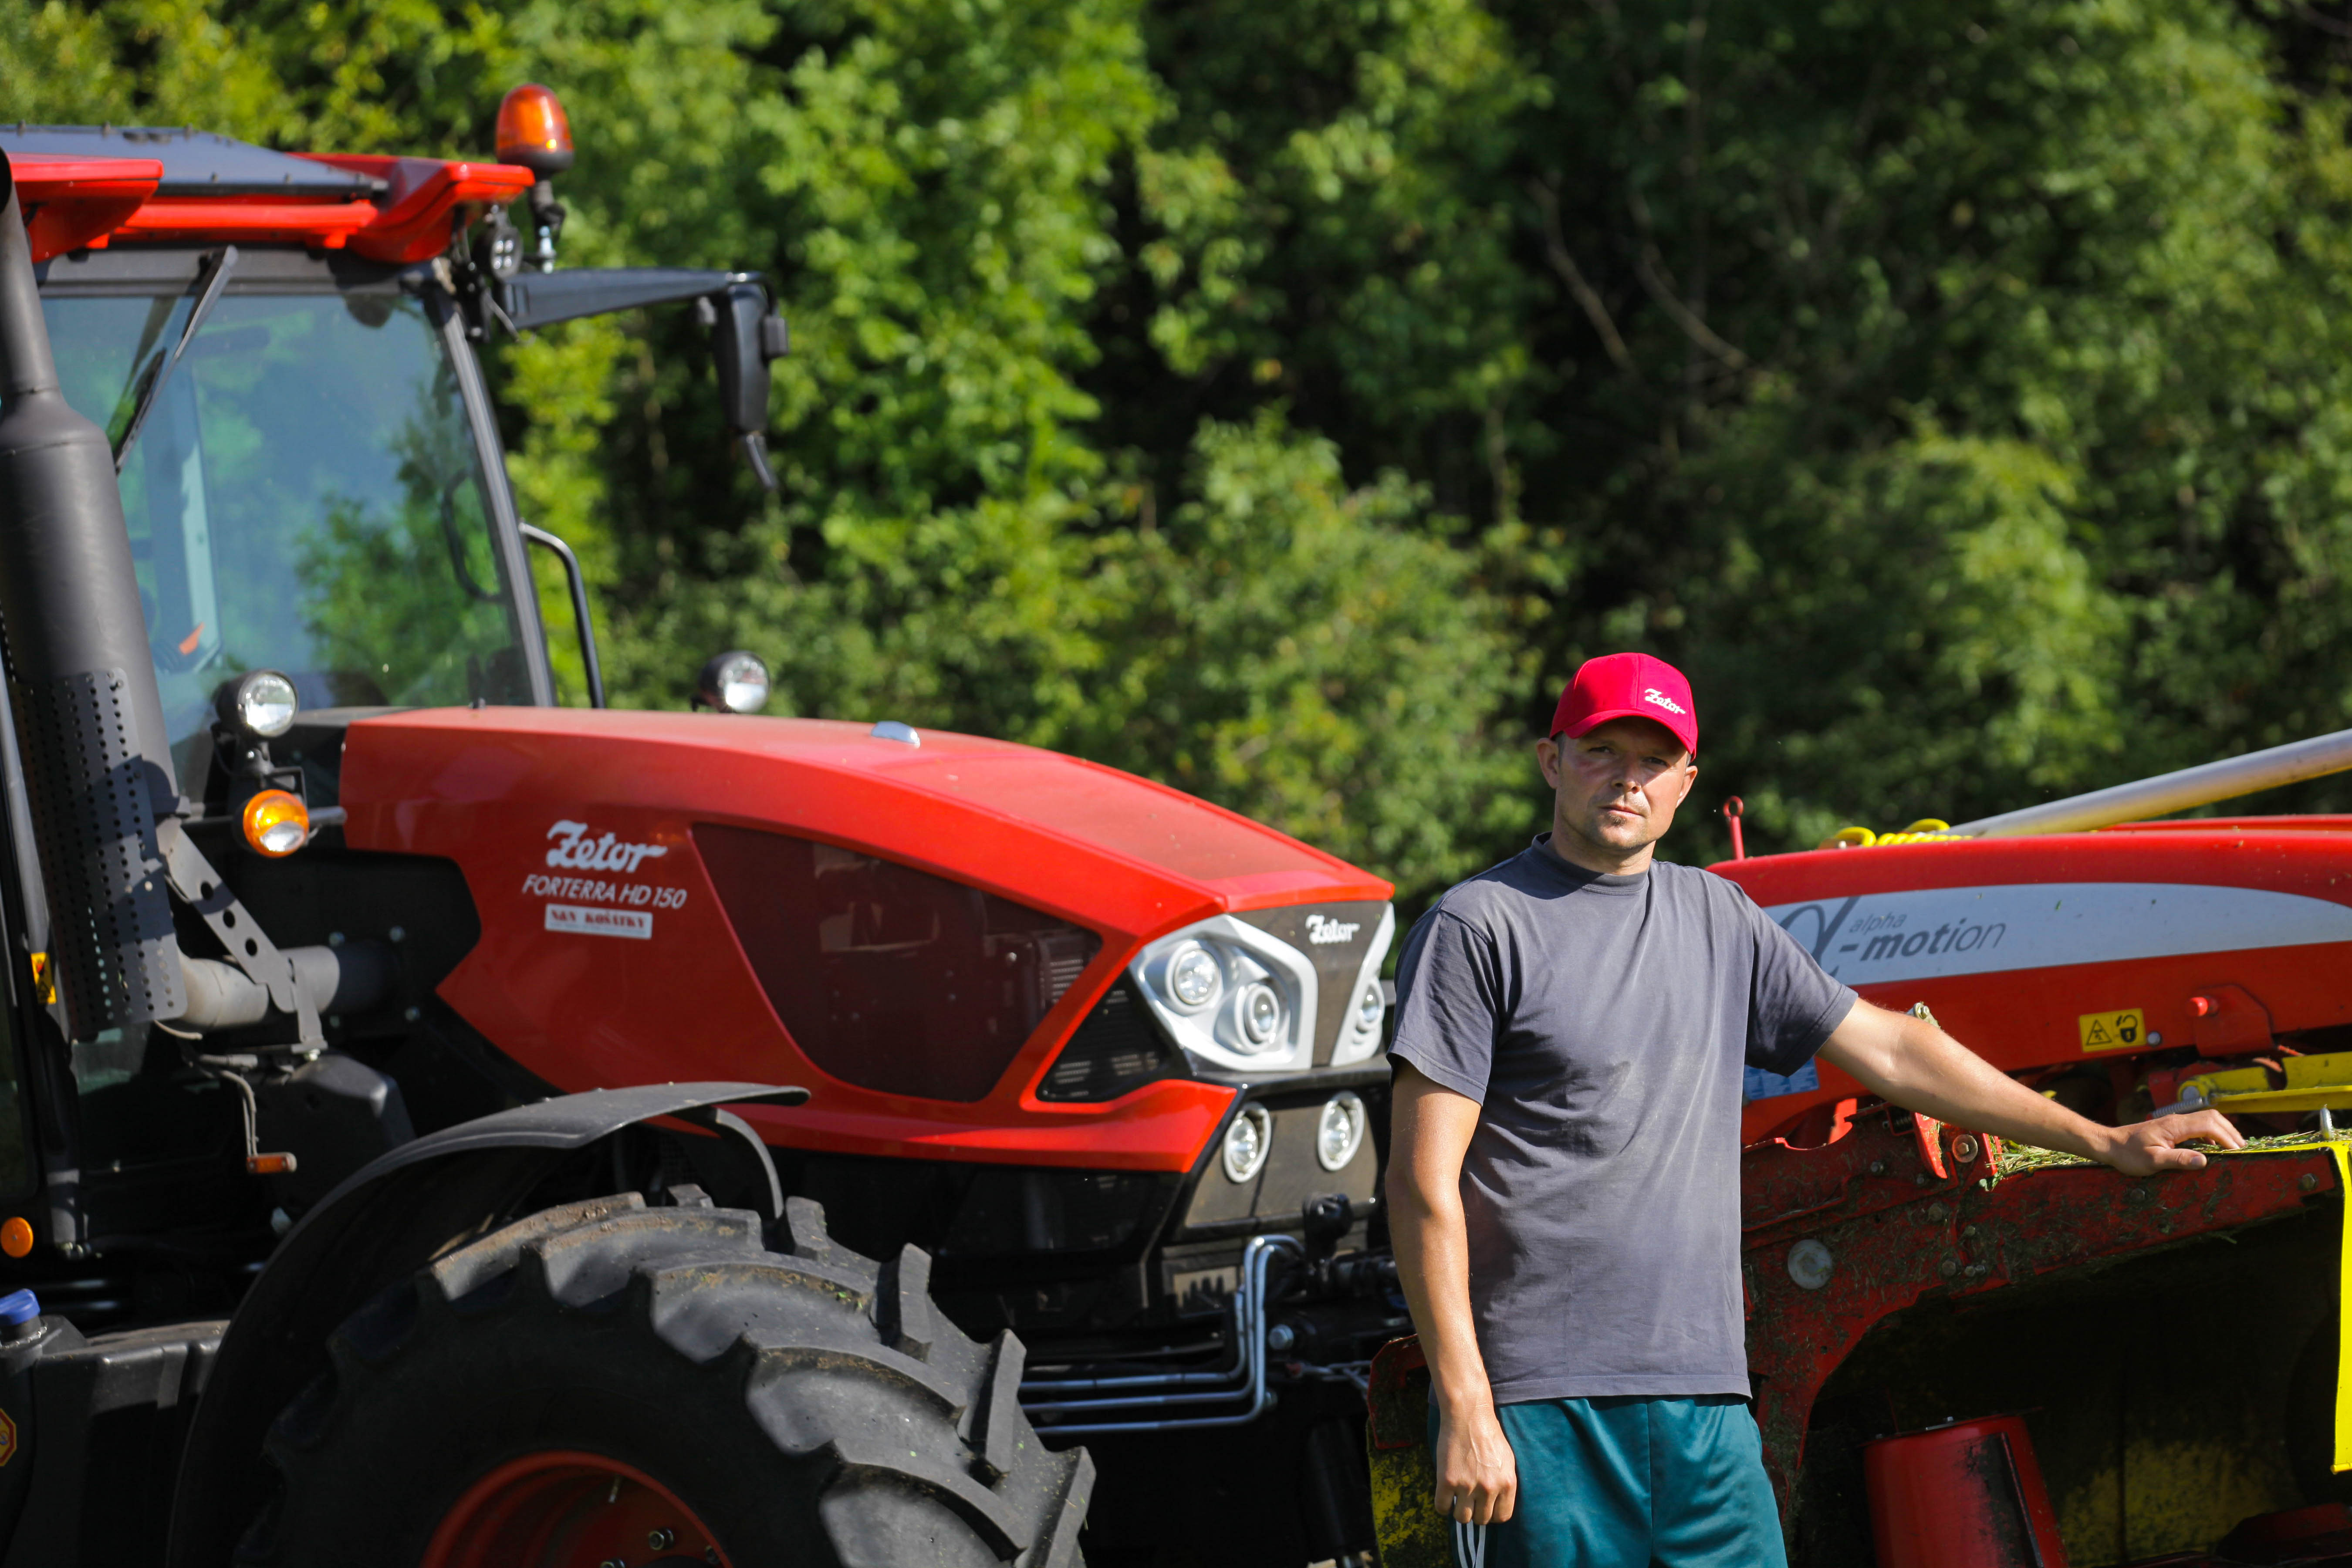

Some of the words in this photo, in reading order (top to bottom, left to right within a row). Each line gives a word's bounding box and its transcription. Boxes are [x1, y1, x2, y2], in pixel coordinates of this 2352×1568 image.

[1644, 688, 1686, 714] Zetor
[546, 820, 668, 873] Zetor
[522, 874, 615, 902] FORTERRA
[618, 884, 652, 905] HD
[652, 887, 688, 909] 150
[1306, 914, 1361, 945] Zetor
[1849, 912, 1907, 936] alpha
